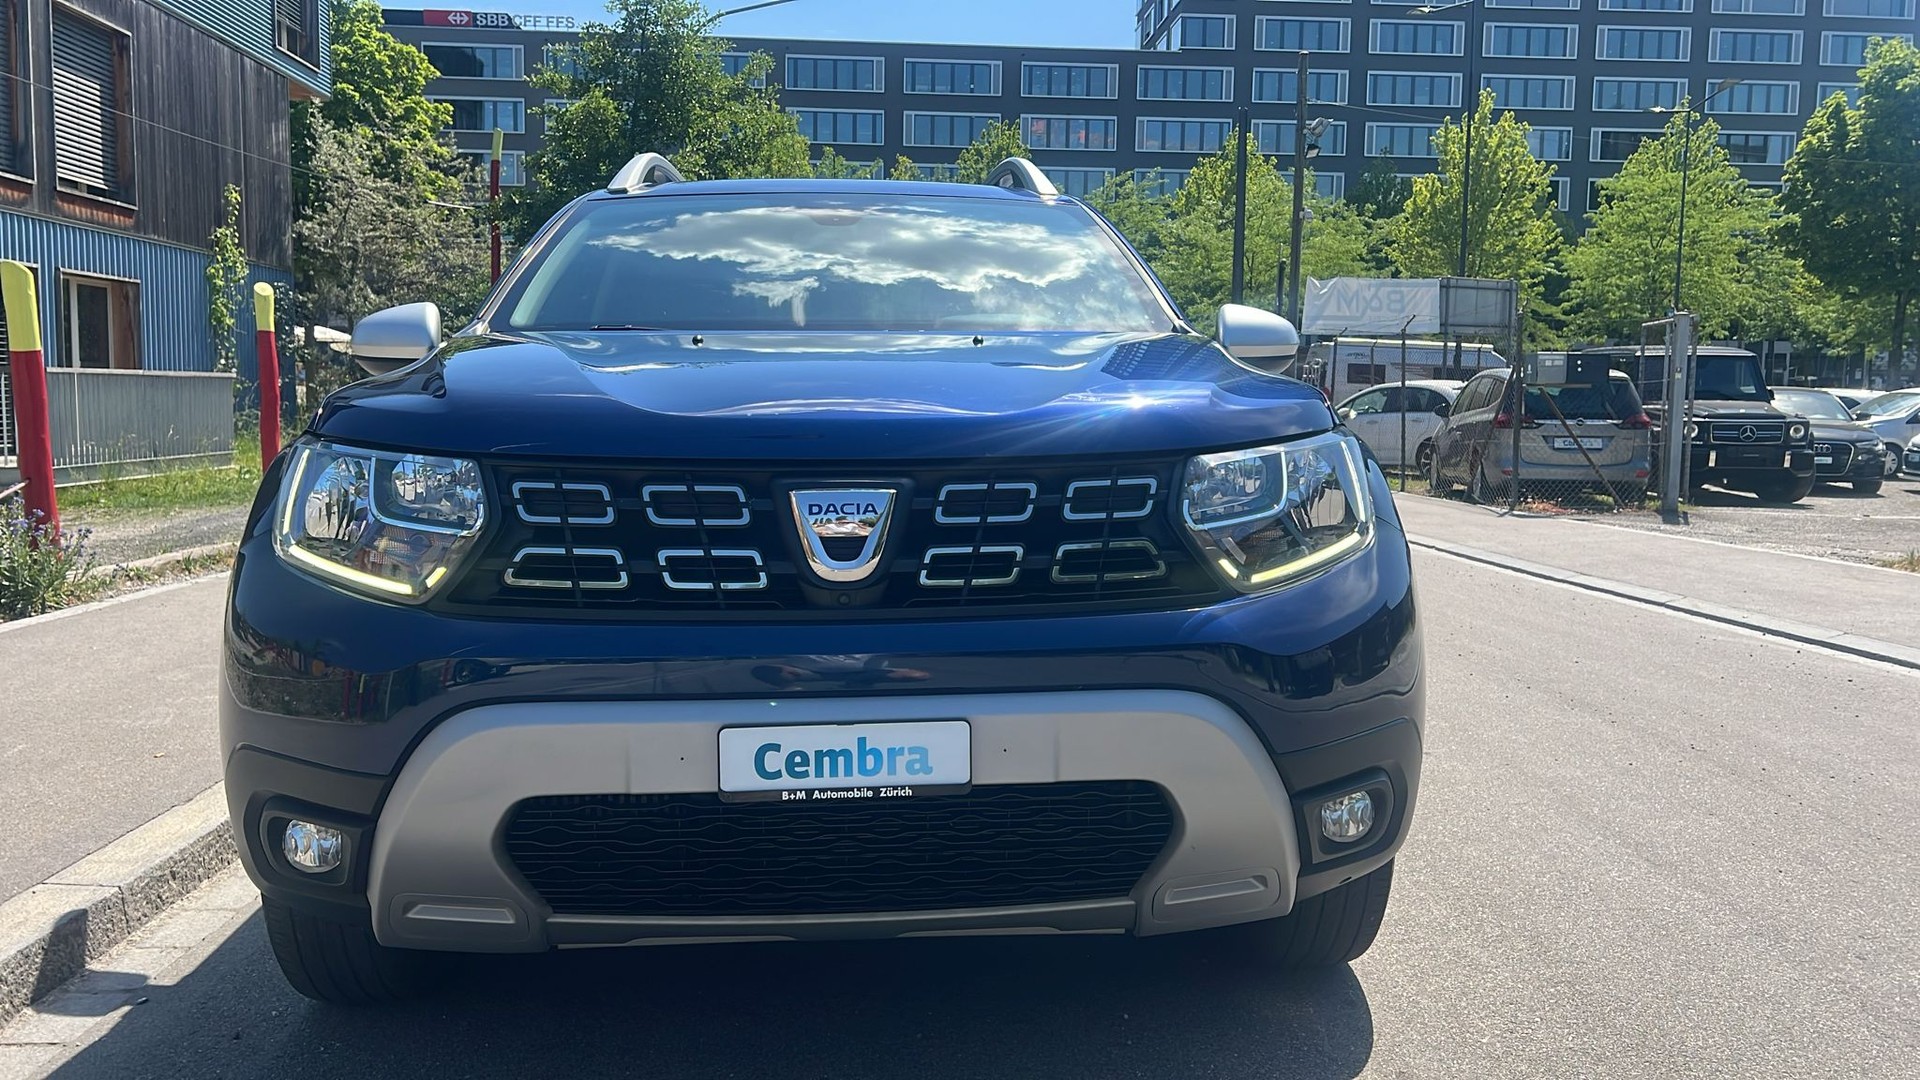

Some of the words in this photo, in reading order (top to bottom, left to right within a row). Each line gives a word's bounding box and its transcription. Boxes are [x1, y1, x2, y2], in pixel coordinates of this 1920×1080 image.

[476, 13, 508, 26] SBB
[512, 14, 542, 28] CFF
[546, 15, 575, 29] FFS
[808, 503, 878, 515] DACIA
[753, 736, 933, 781] Cembra
[782, 790, 806, 800] B+M
[813, 788, 873, 800] Automobile
[879, 786, 912, 797] Zürich
